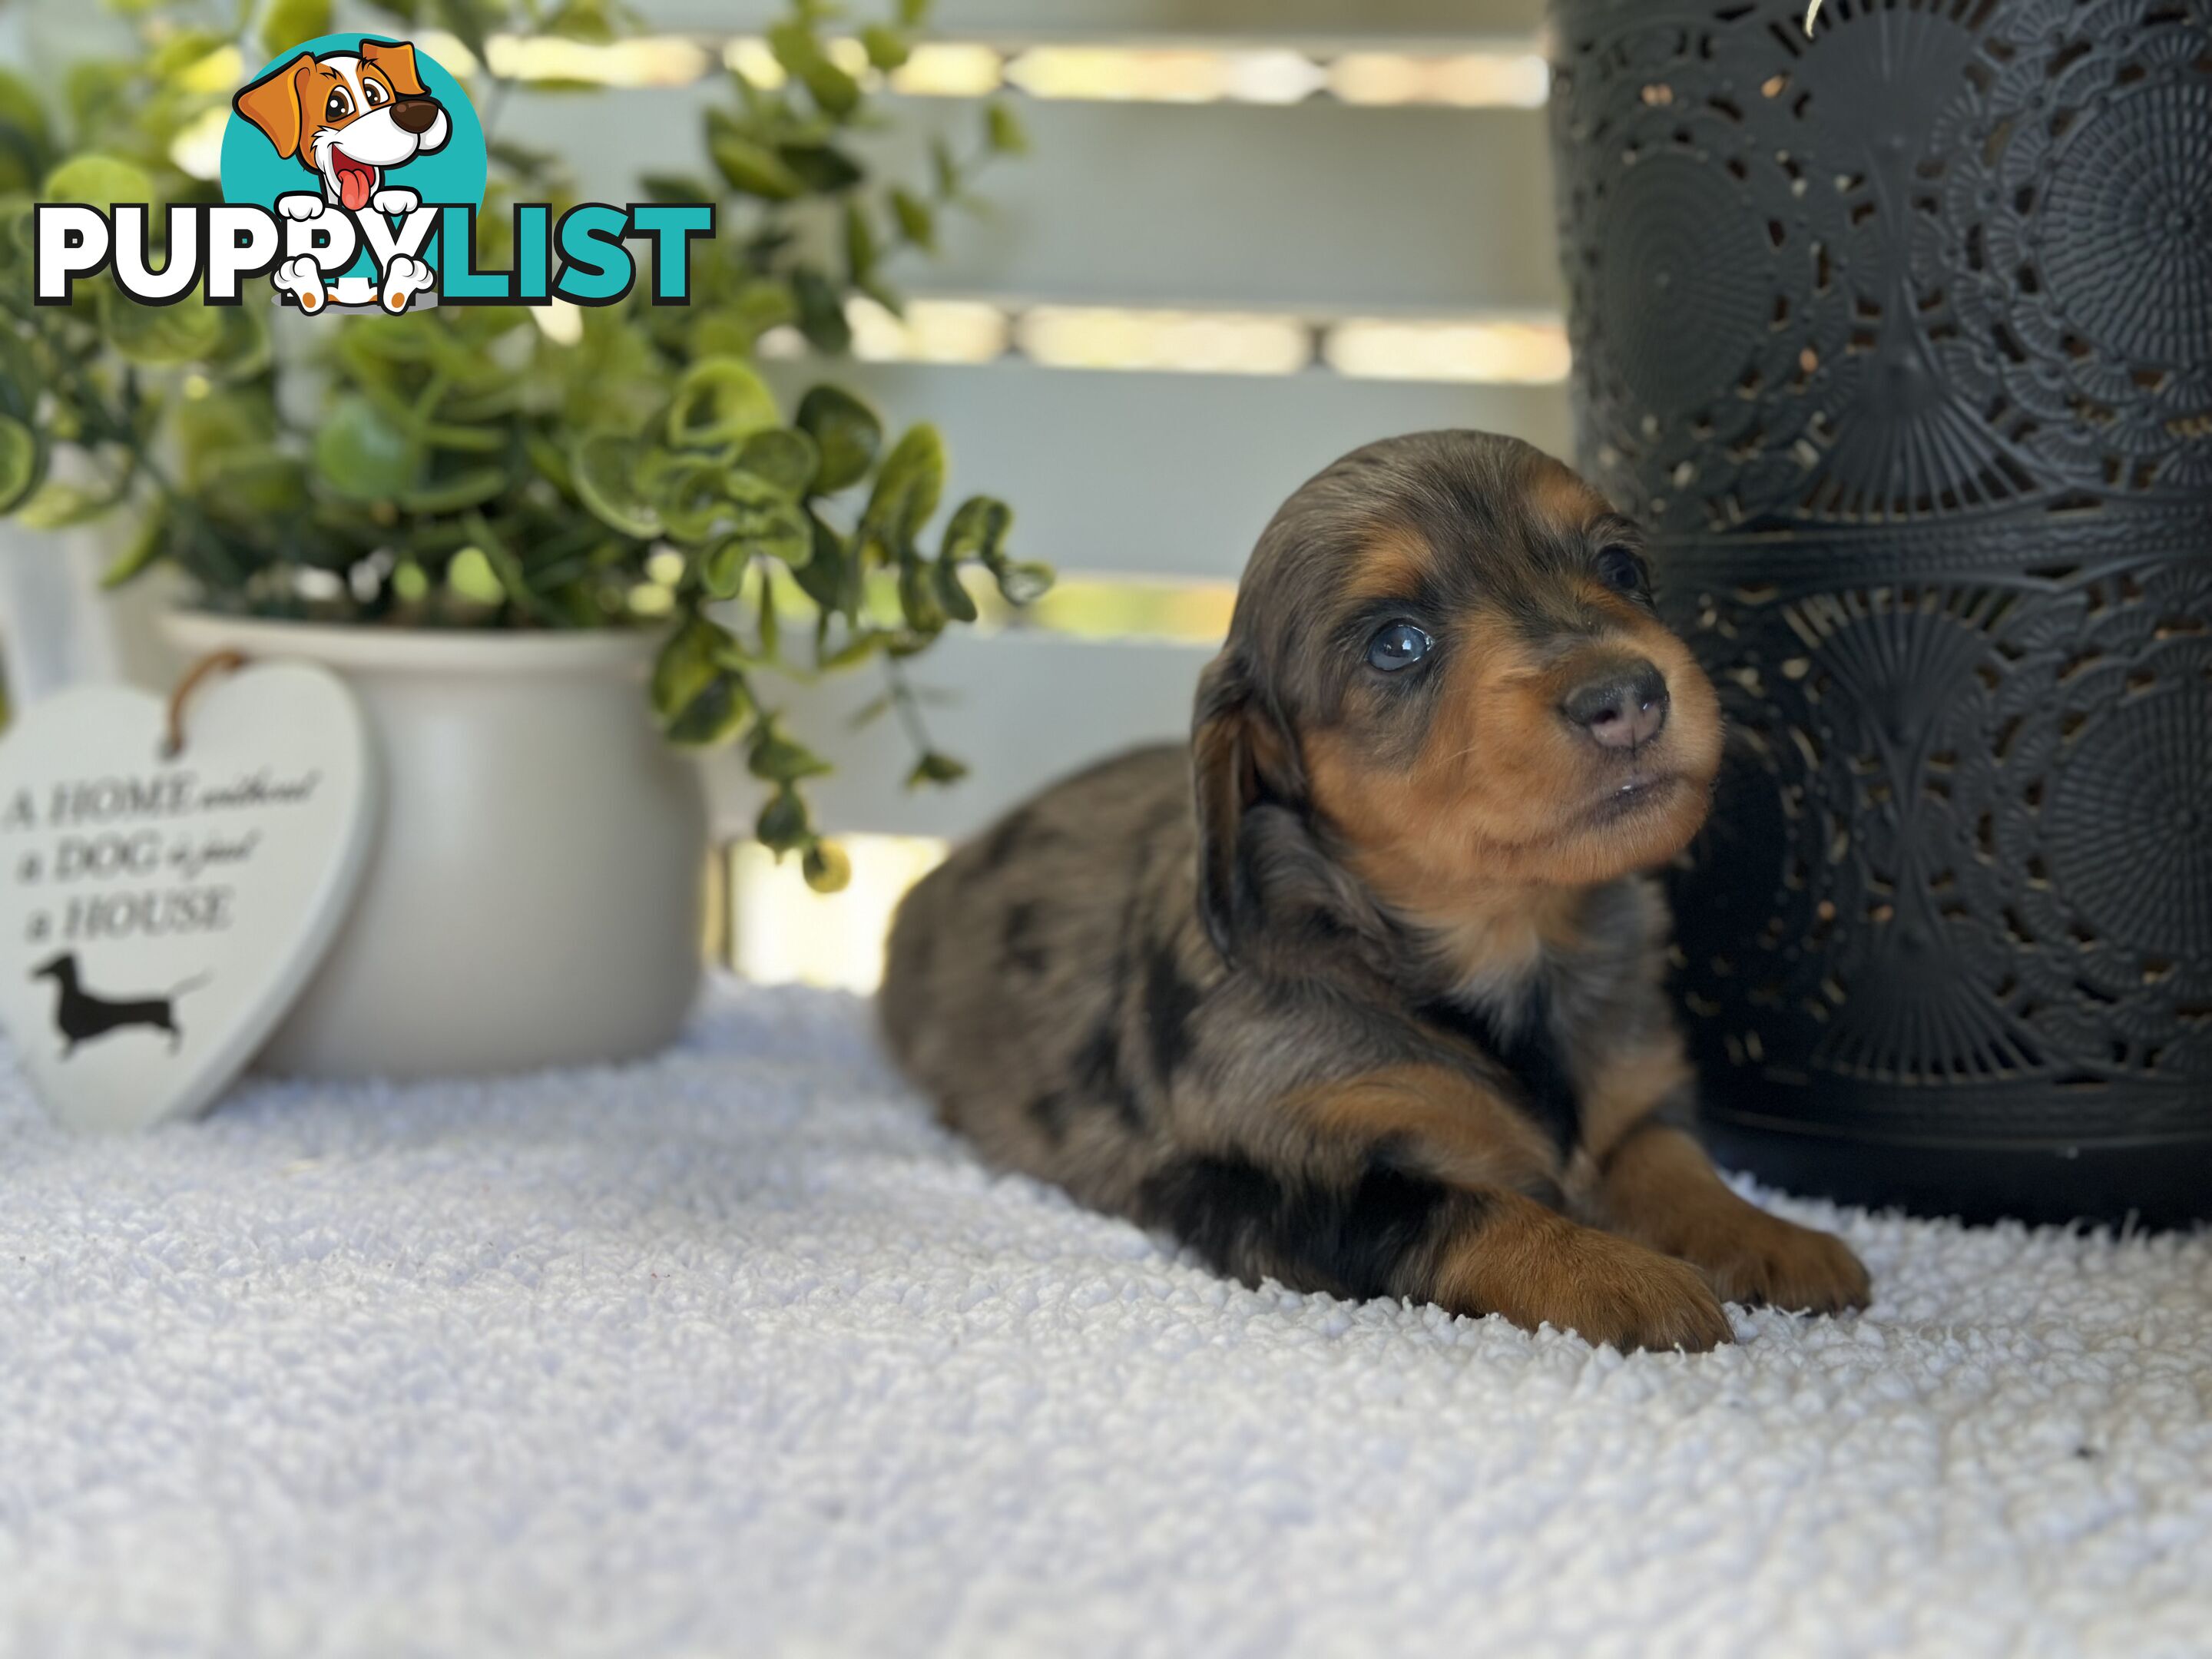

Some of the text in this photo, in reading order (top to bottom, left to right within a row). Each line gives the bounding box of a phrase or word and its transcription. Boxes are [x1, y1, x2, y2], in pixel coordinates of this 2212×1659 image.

[4, 786, 35, 831] A
[50, 772, 197, 827] HOME
[55, 830, 162, 882] DOG
[64, 884, 235, 939] HOUSE
